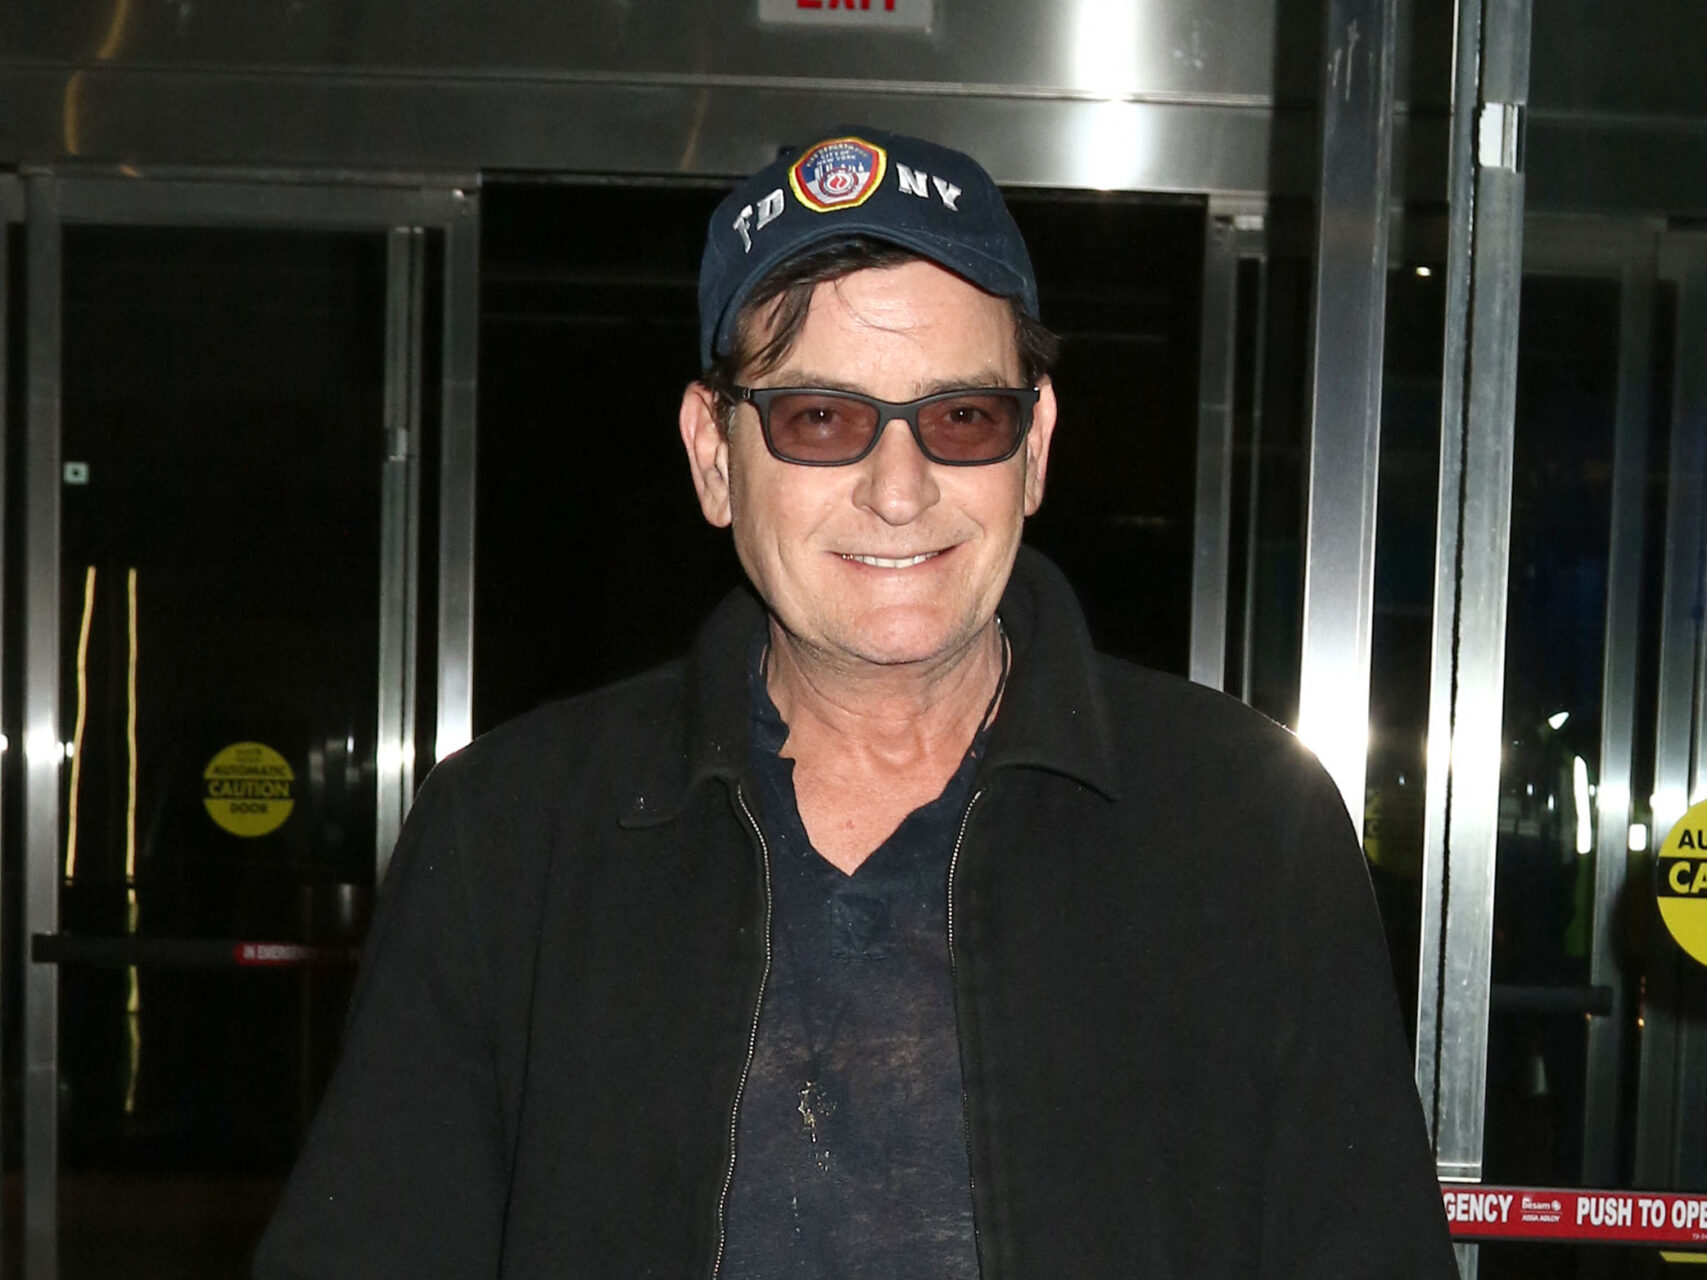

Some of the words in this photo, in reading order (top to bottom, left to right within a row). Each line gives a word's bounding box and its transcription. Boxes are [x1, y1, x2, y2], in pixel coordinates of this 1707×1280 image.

[896, 162, 962, 211] NY
[208, 781, 290, 797] CAUTION
[230, 802, 268, 814] DOOR
[1668, 860, 1707, 894] CA
[1576, 1197, 1632, 1226] PUSH
[1638, 1199, 1666, 1228] TO
[1672, 1200, 1707, 1228] OPE
